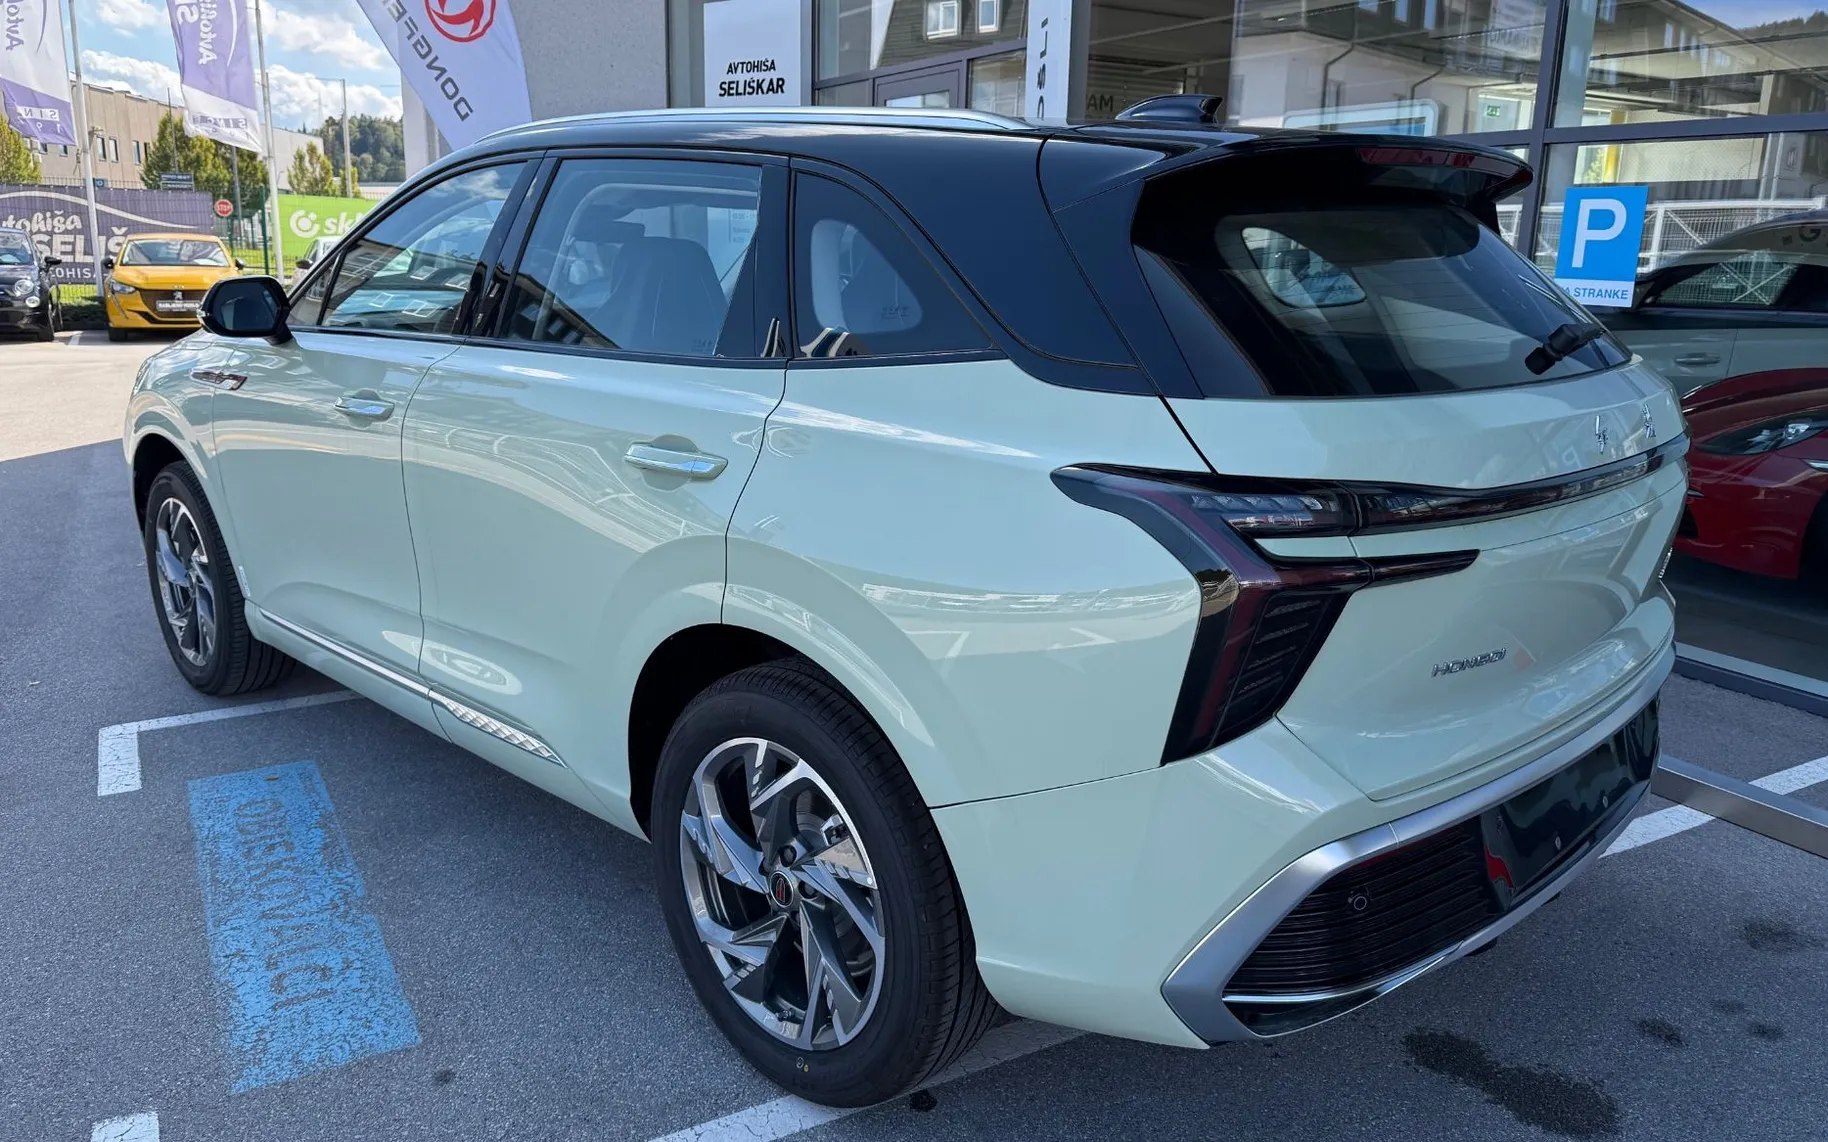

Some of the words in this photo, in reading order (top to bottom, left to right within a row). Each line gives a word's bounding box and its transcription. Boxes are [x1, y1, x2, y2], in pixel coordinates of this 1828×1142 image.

[726, 58, 776, 75] AVTOHIŠA
[718, 77, 785, 98] SELIŠKAR
[1571, 198, 1627, 268] P
[1573, 286, 1629, 300] STRANKE
